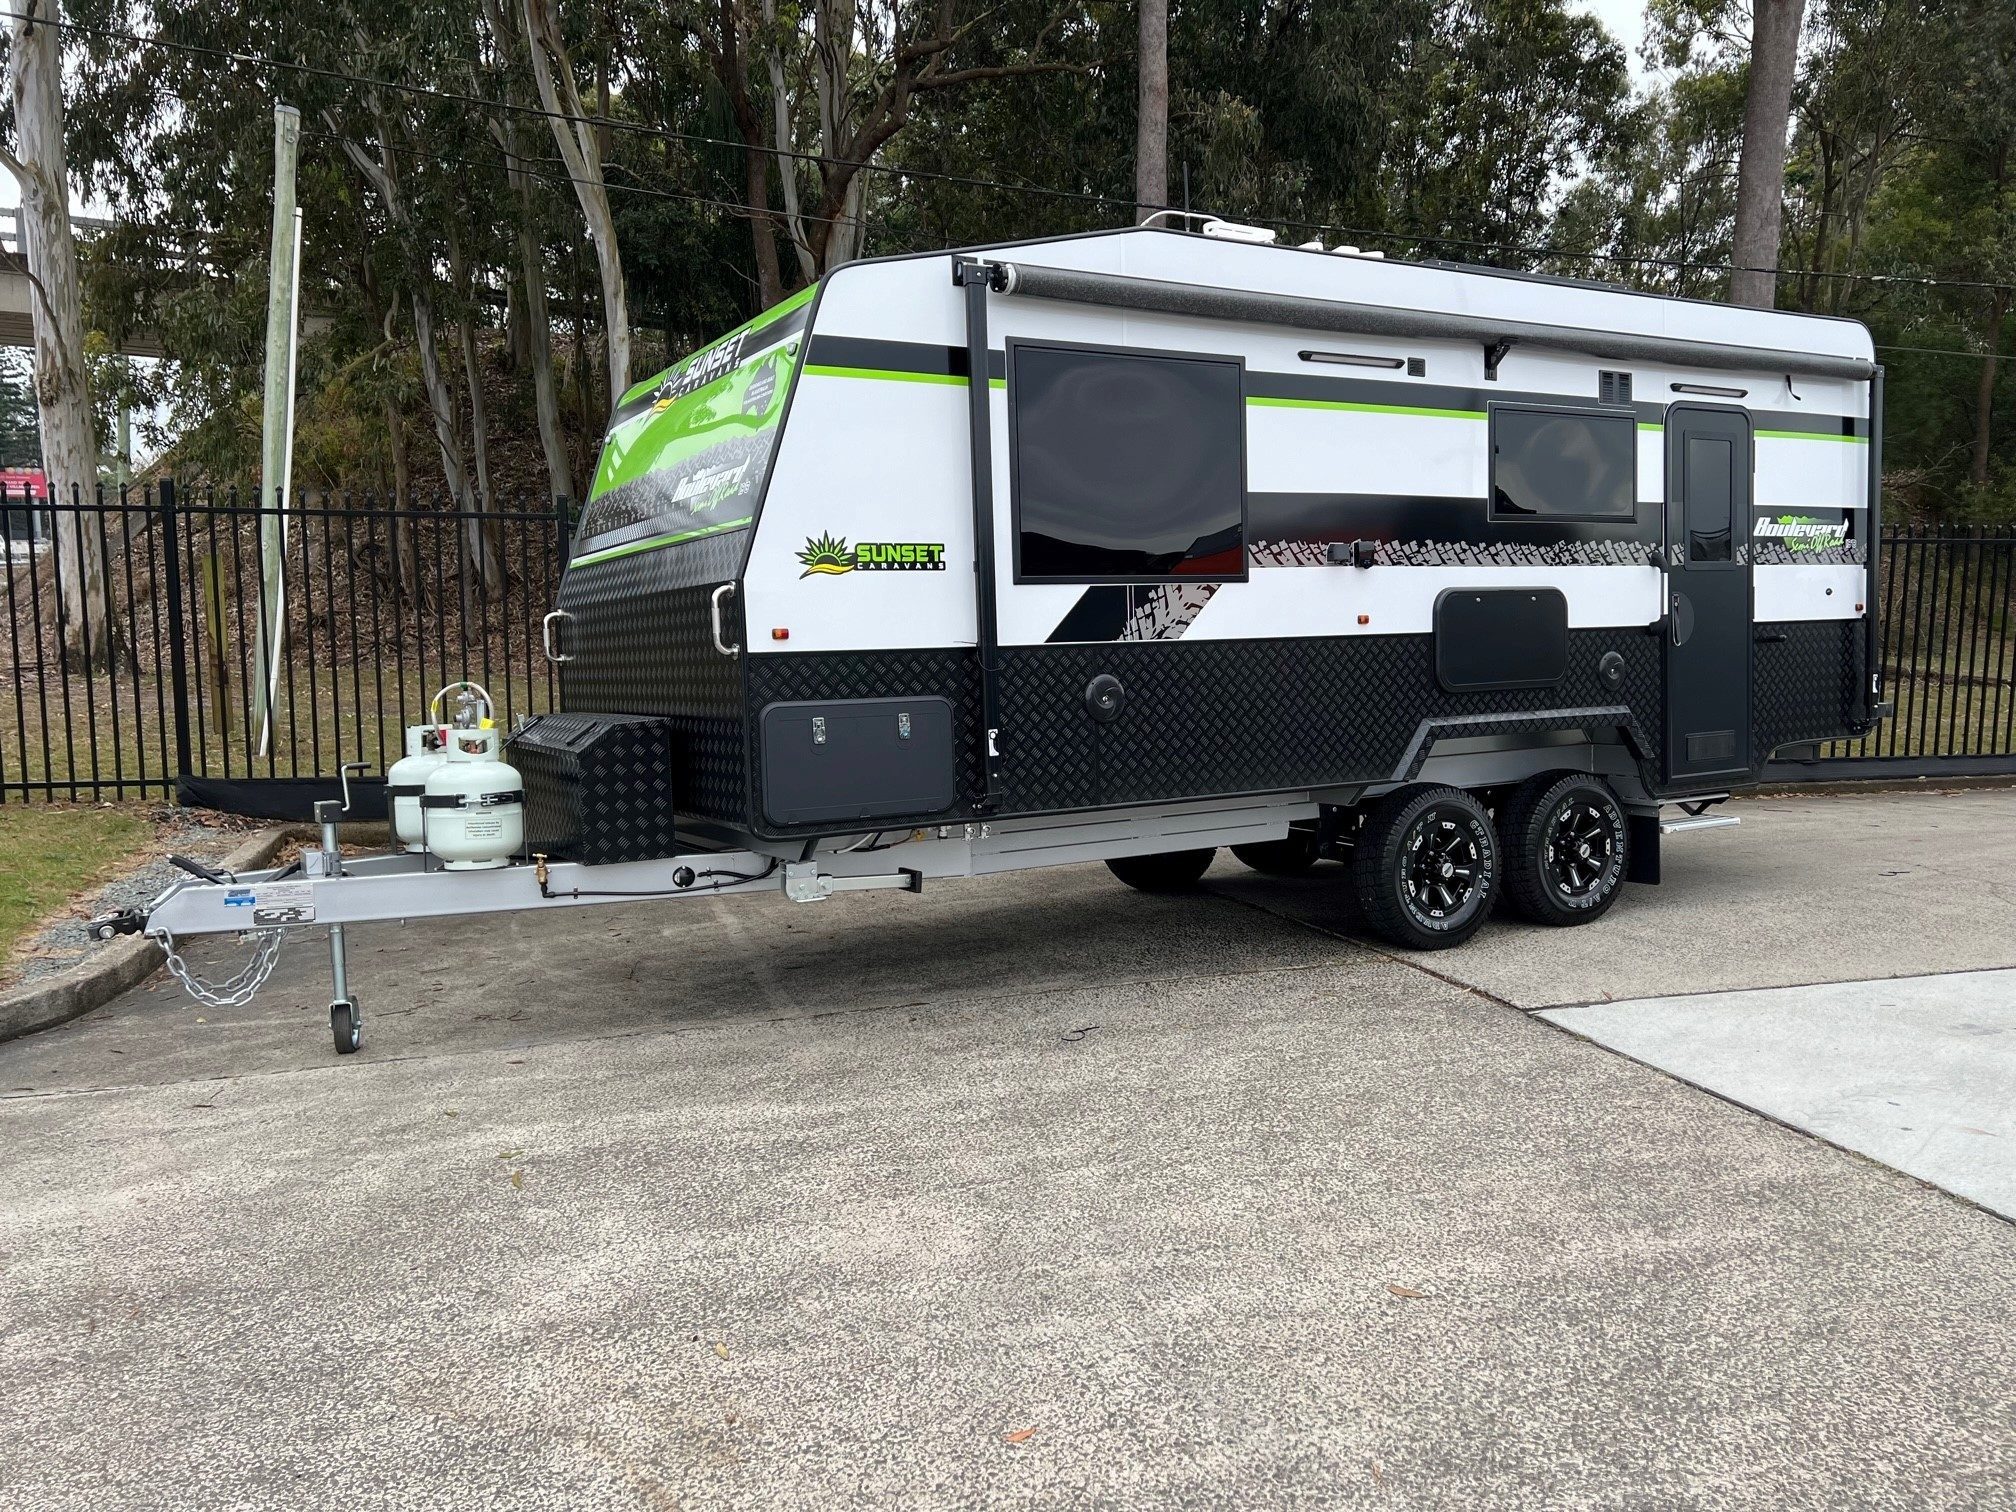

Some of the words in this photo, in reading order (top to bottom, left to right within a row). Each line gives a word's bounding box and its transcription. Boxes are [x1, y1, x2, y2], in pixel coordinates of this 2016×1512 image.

[682, 327, 751, 386] SUNSET
[678, 357, 741, 398] CARAVANS
[1753, 516, 1849, 537] Boulevard
[856, 543, 944, 562] SUNSET
[857, 562, 945, 570] CARAVANS
